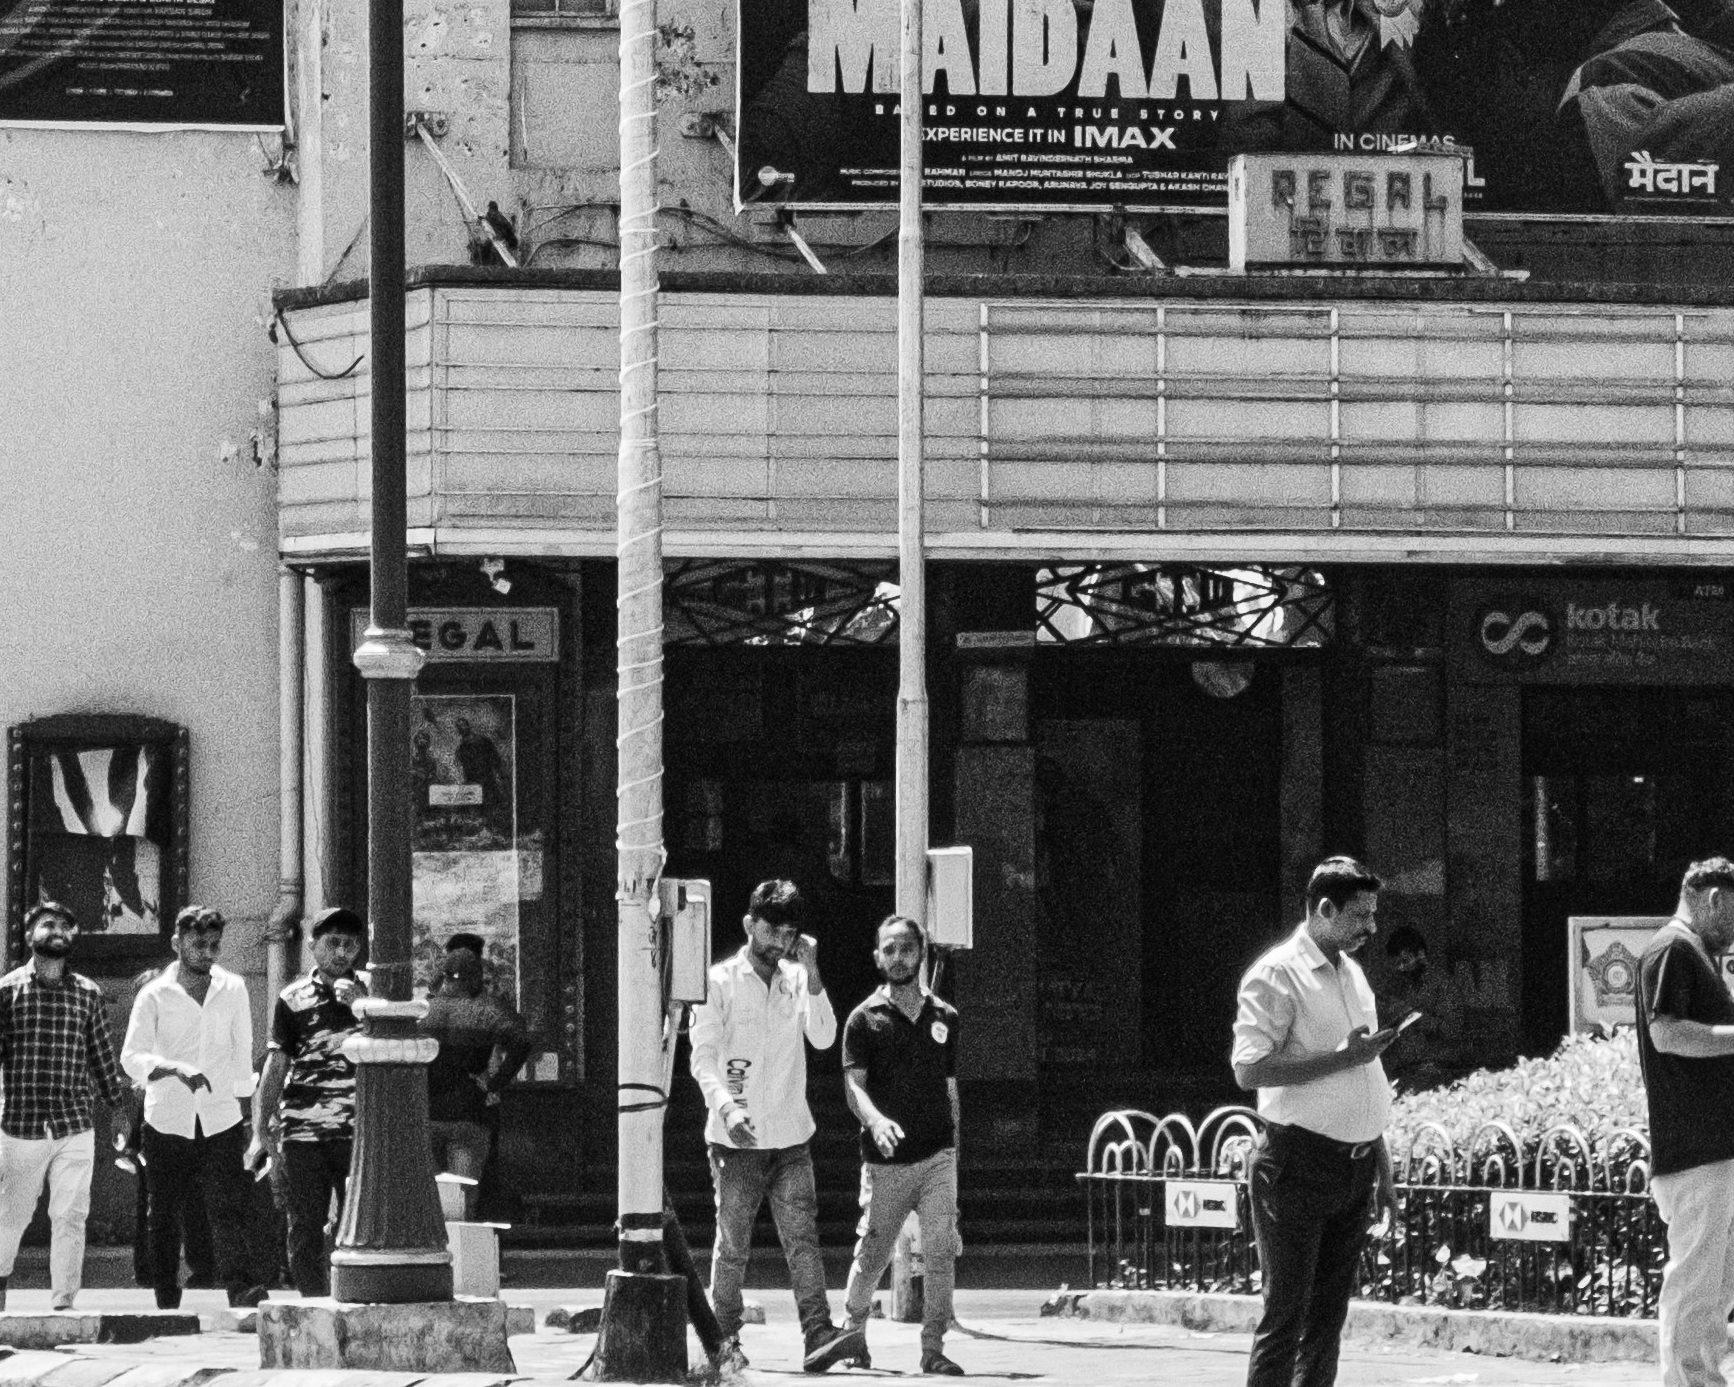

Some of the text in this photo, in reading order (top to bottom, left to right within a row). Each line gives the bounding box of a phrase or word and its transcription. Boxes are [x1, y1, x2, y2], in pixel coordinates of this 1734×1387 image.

[875, 104, 1219, 121] BAED ON A TRUE STORY
[1028, 129, 1044, 143] IT
[1048, 129, 1066, 143] IN
[1074, 125, 1177, 149] IMAX
[1334, 133, 1354, 150] IN
[1624, 150, 1720, 194] मैदान
[1271, 169, 1448, 213] REGAL
[1566, 601, 1661, 630] kotak
[408, 620, 535, 650] EGAL
